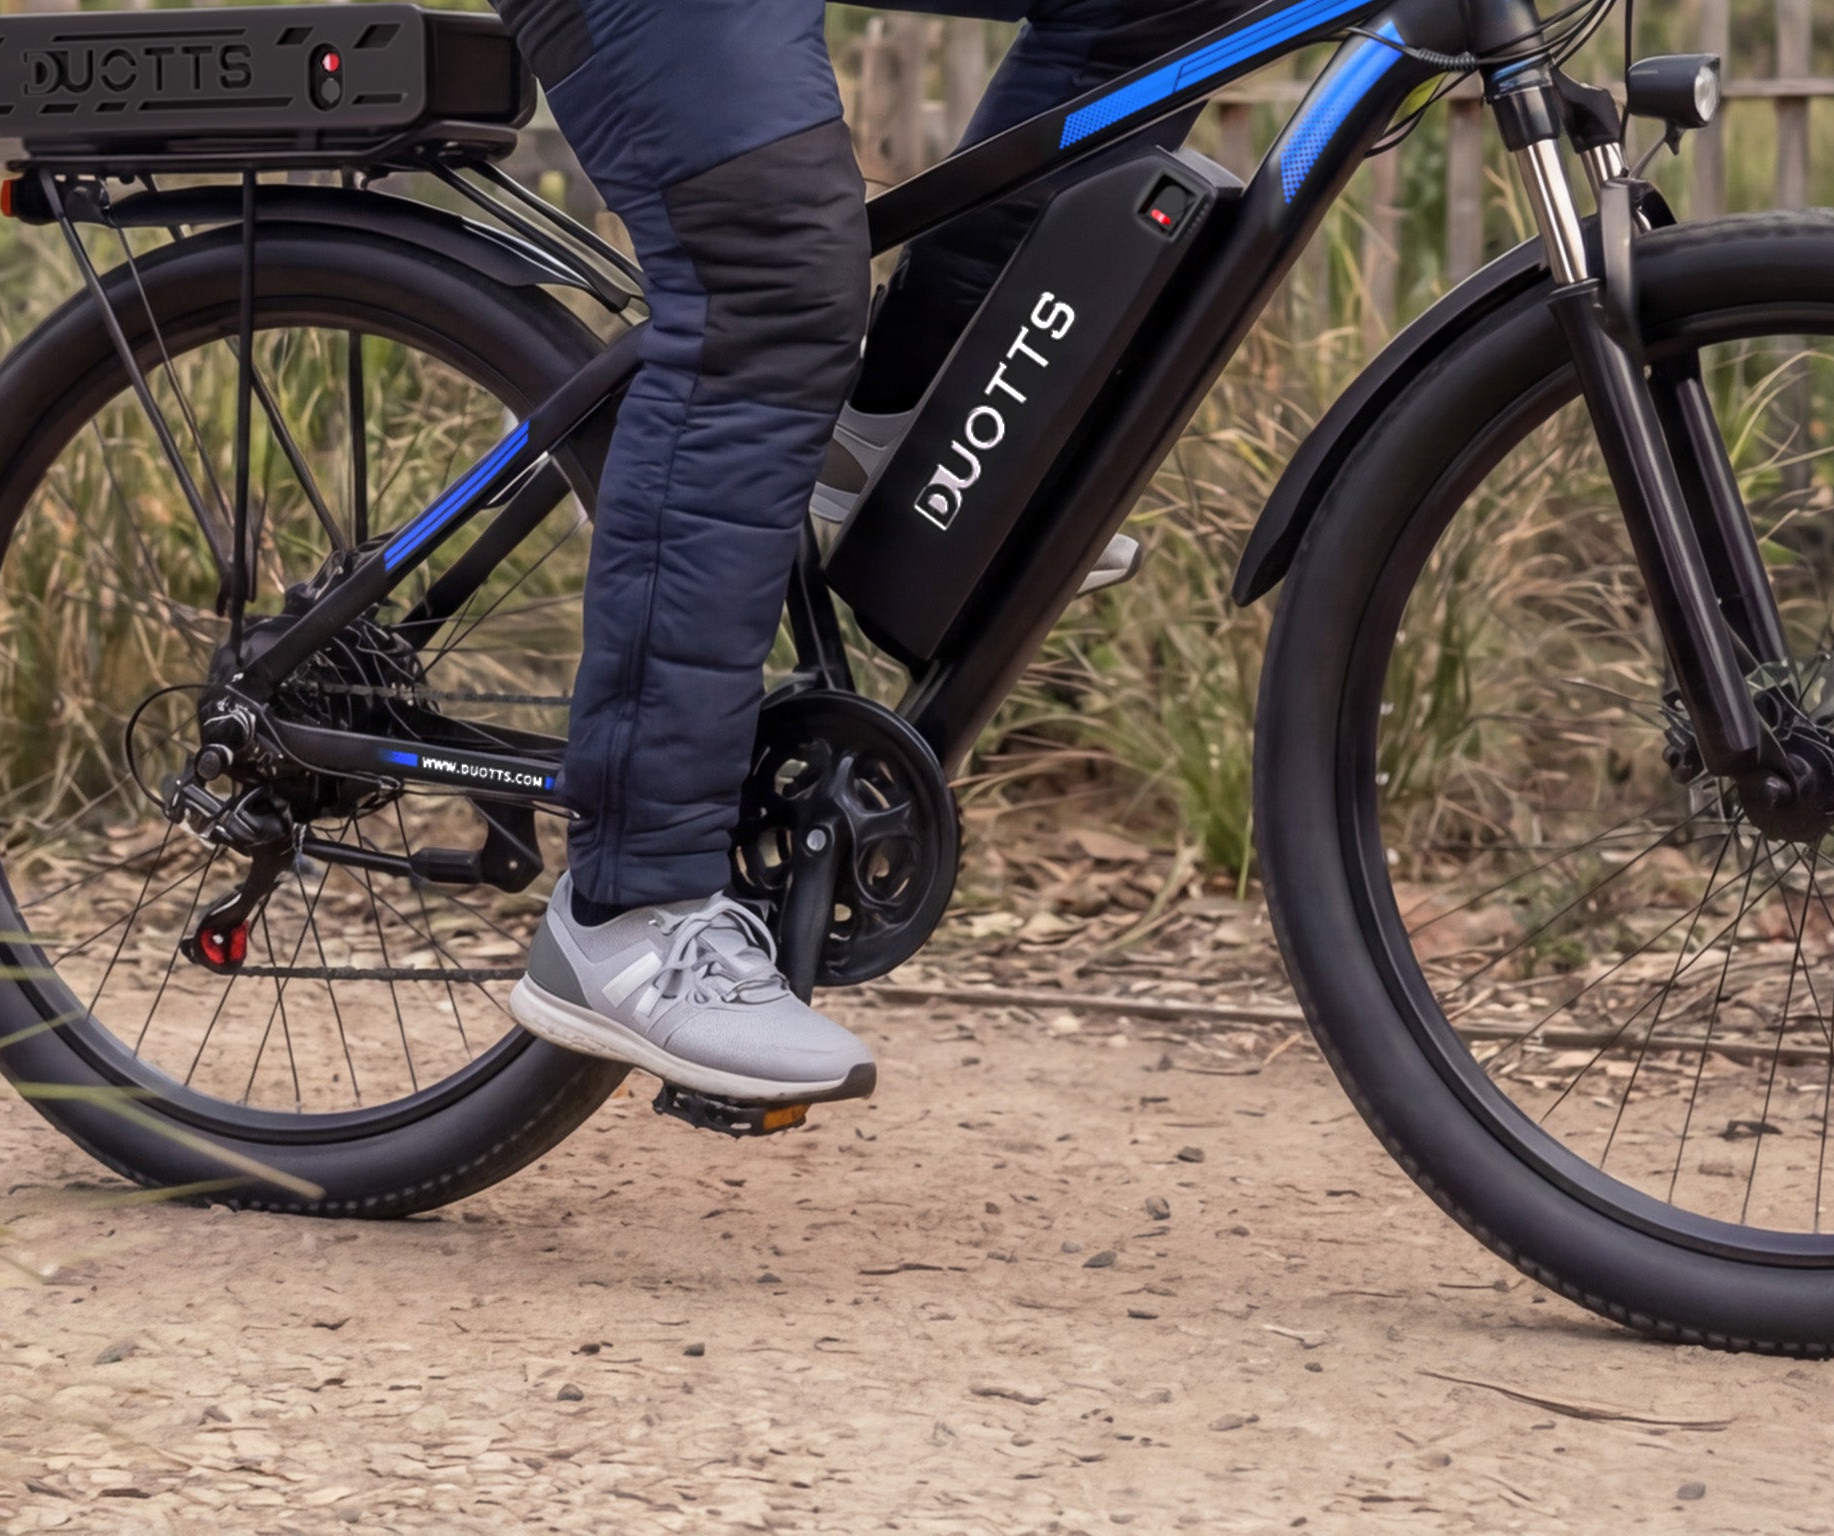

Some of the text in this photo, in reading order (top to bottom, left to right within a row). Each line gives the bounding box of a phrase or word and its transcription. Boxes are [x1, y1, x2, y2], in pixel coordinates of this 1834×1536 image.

[22, 43, 253, 96] DUOTTS
[914, 290, 1077, 531] DUOTTS
[421, 756, 543, 788] WWW.DUOTTS.COM
